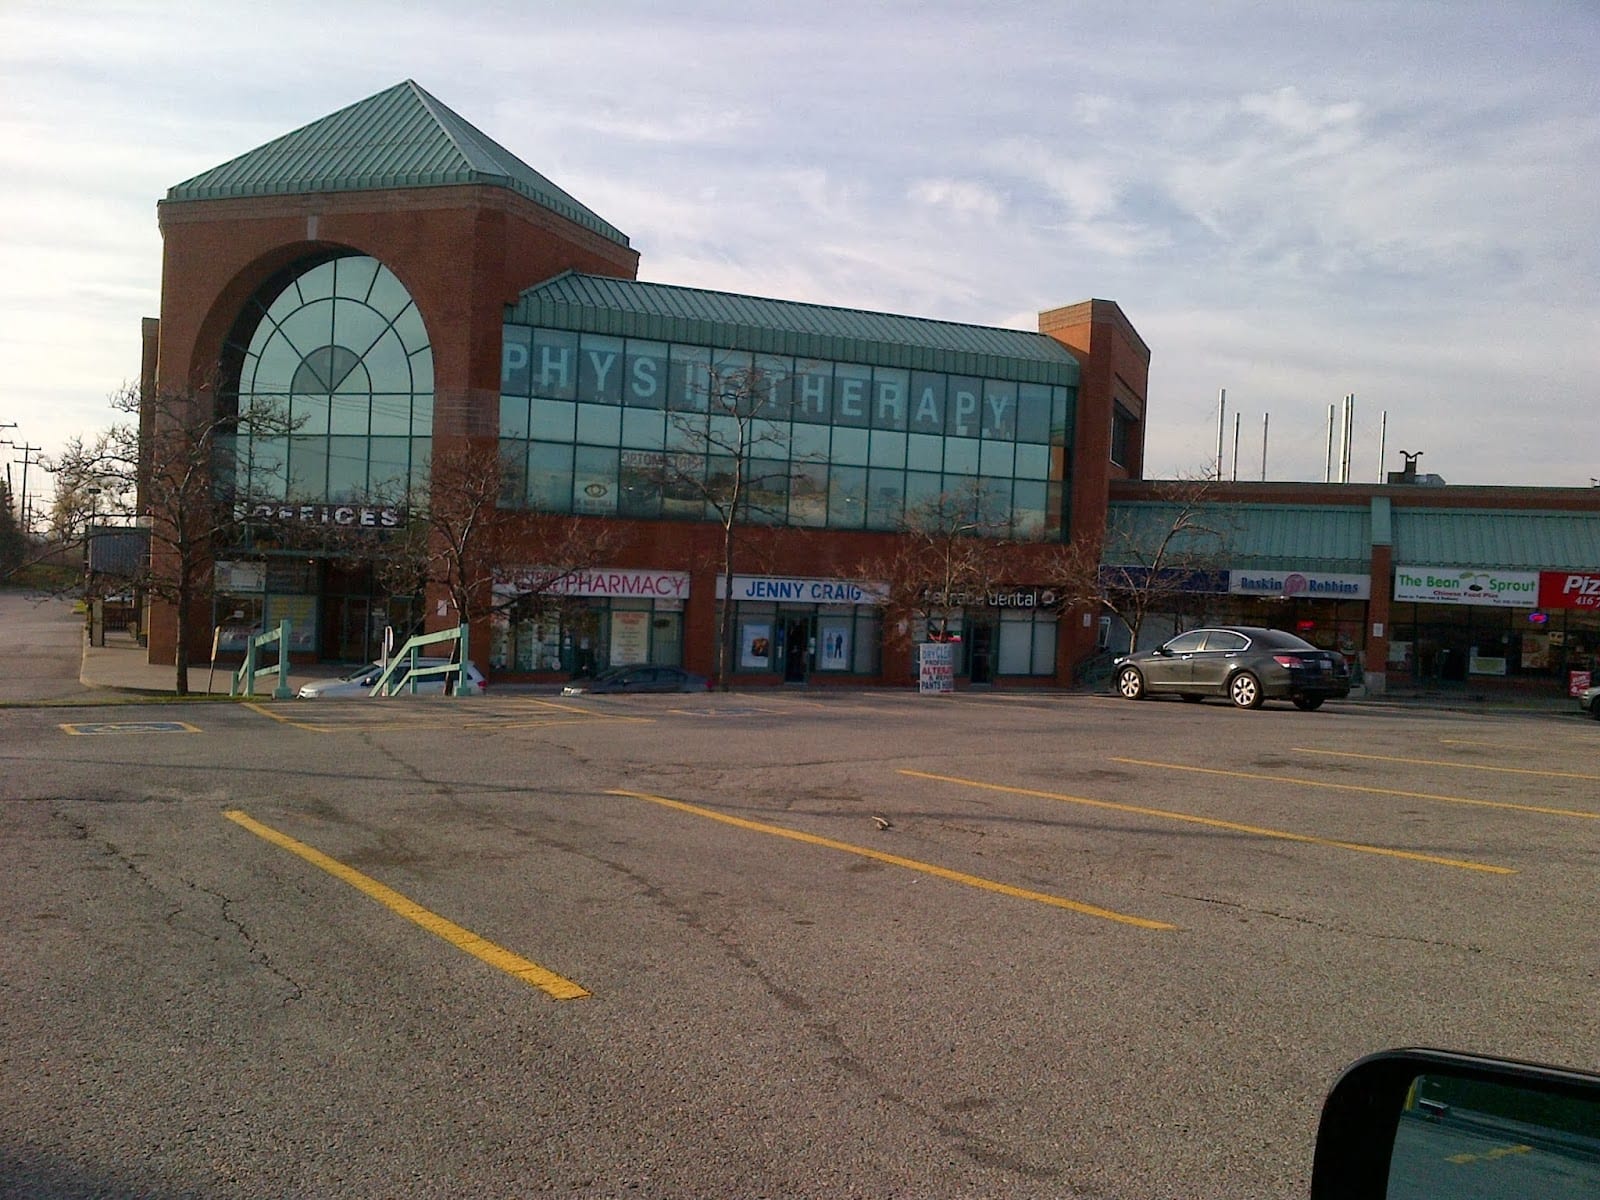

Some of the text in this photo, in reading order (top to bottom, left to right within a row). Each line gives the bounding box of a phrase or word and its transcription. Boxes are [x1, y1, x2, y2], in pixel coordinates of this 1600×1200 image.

[565, 571, 686, 596] PHARMACY
[746, 581, 862, 600] JENNY CRAIG
[1241, 577, 1283, 591] Baskin
[1309, 579, 1359, 593] Robbins
[1399, 574, 1536, 592] The Bean Sprout
[989, 590, 1037, 606] dental
[1575, 595, 1594, 606] 416
